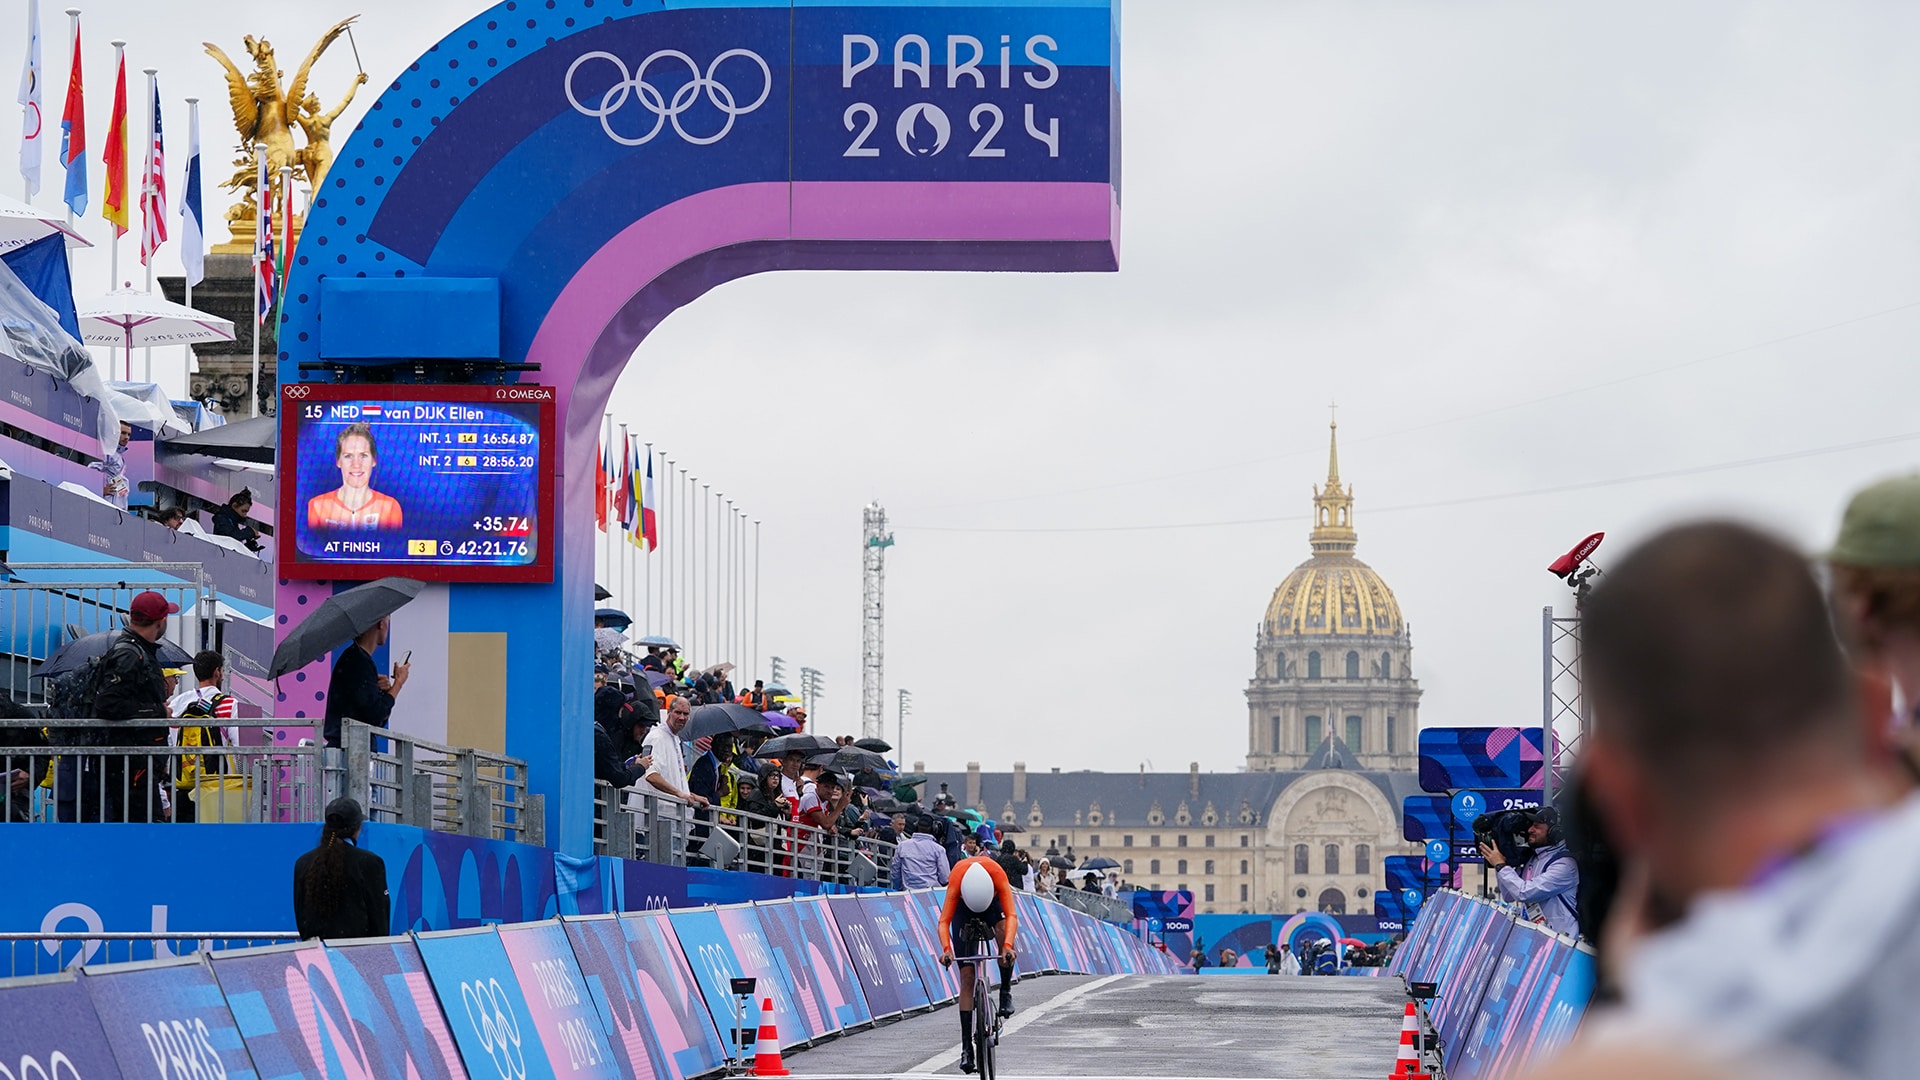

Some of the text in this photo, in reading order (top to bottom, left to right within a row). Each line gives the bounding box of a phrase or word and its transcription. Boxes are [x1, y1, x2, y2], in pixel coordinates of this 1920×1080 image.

[842, 102, 1060, 158] 2024
[508, 389, 551, 400] OMEGA
[304, 405, 484, 420] 15 NED van DIJK Ellen
[419, 432, 535, 445] INT. 1 14 16:54.87
[419, 455, 535, 468] INT. 2 6 28:56.20
[473, 516, 529, 532] +35.74
[324, 541, 528, 556] AT FINISH 3 42:21.76
[1579, 537, 1600, 556] OMEGA
[1503, 798, 1539, 810] 25m
[1165, 922, 1190, 930] 100m
[1378, 921, 1403, 930] 100m
[557, 1016, 604, 1072] 2024
